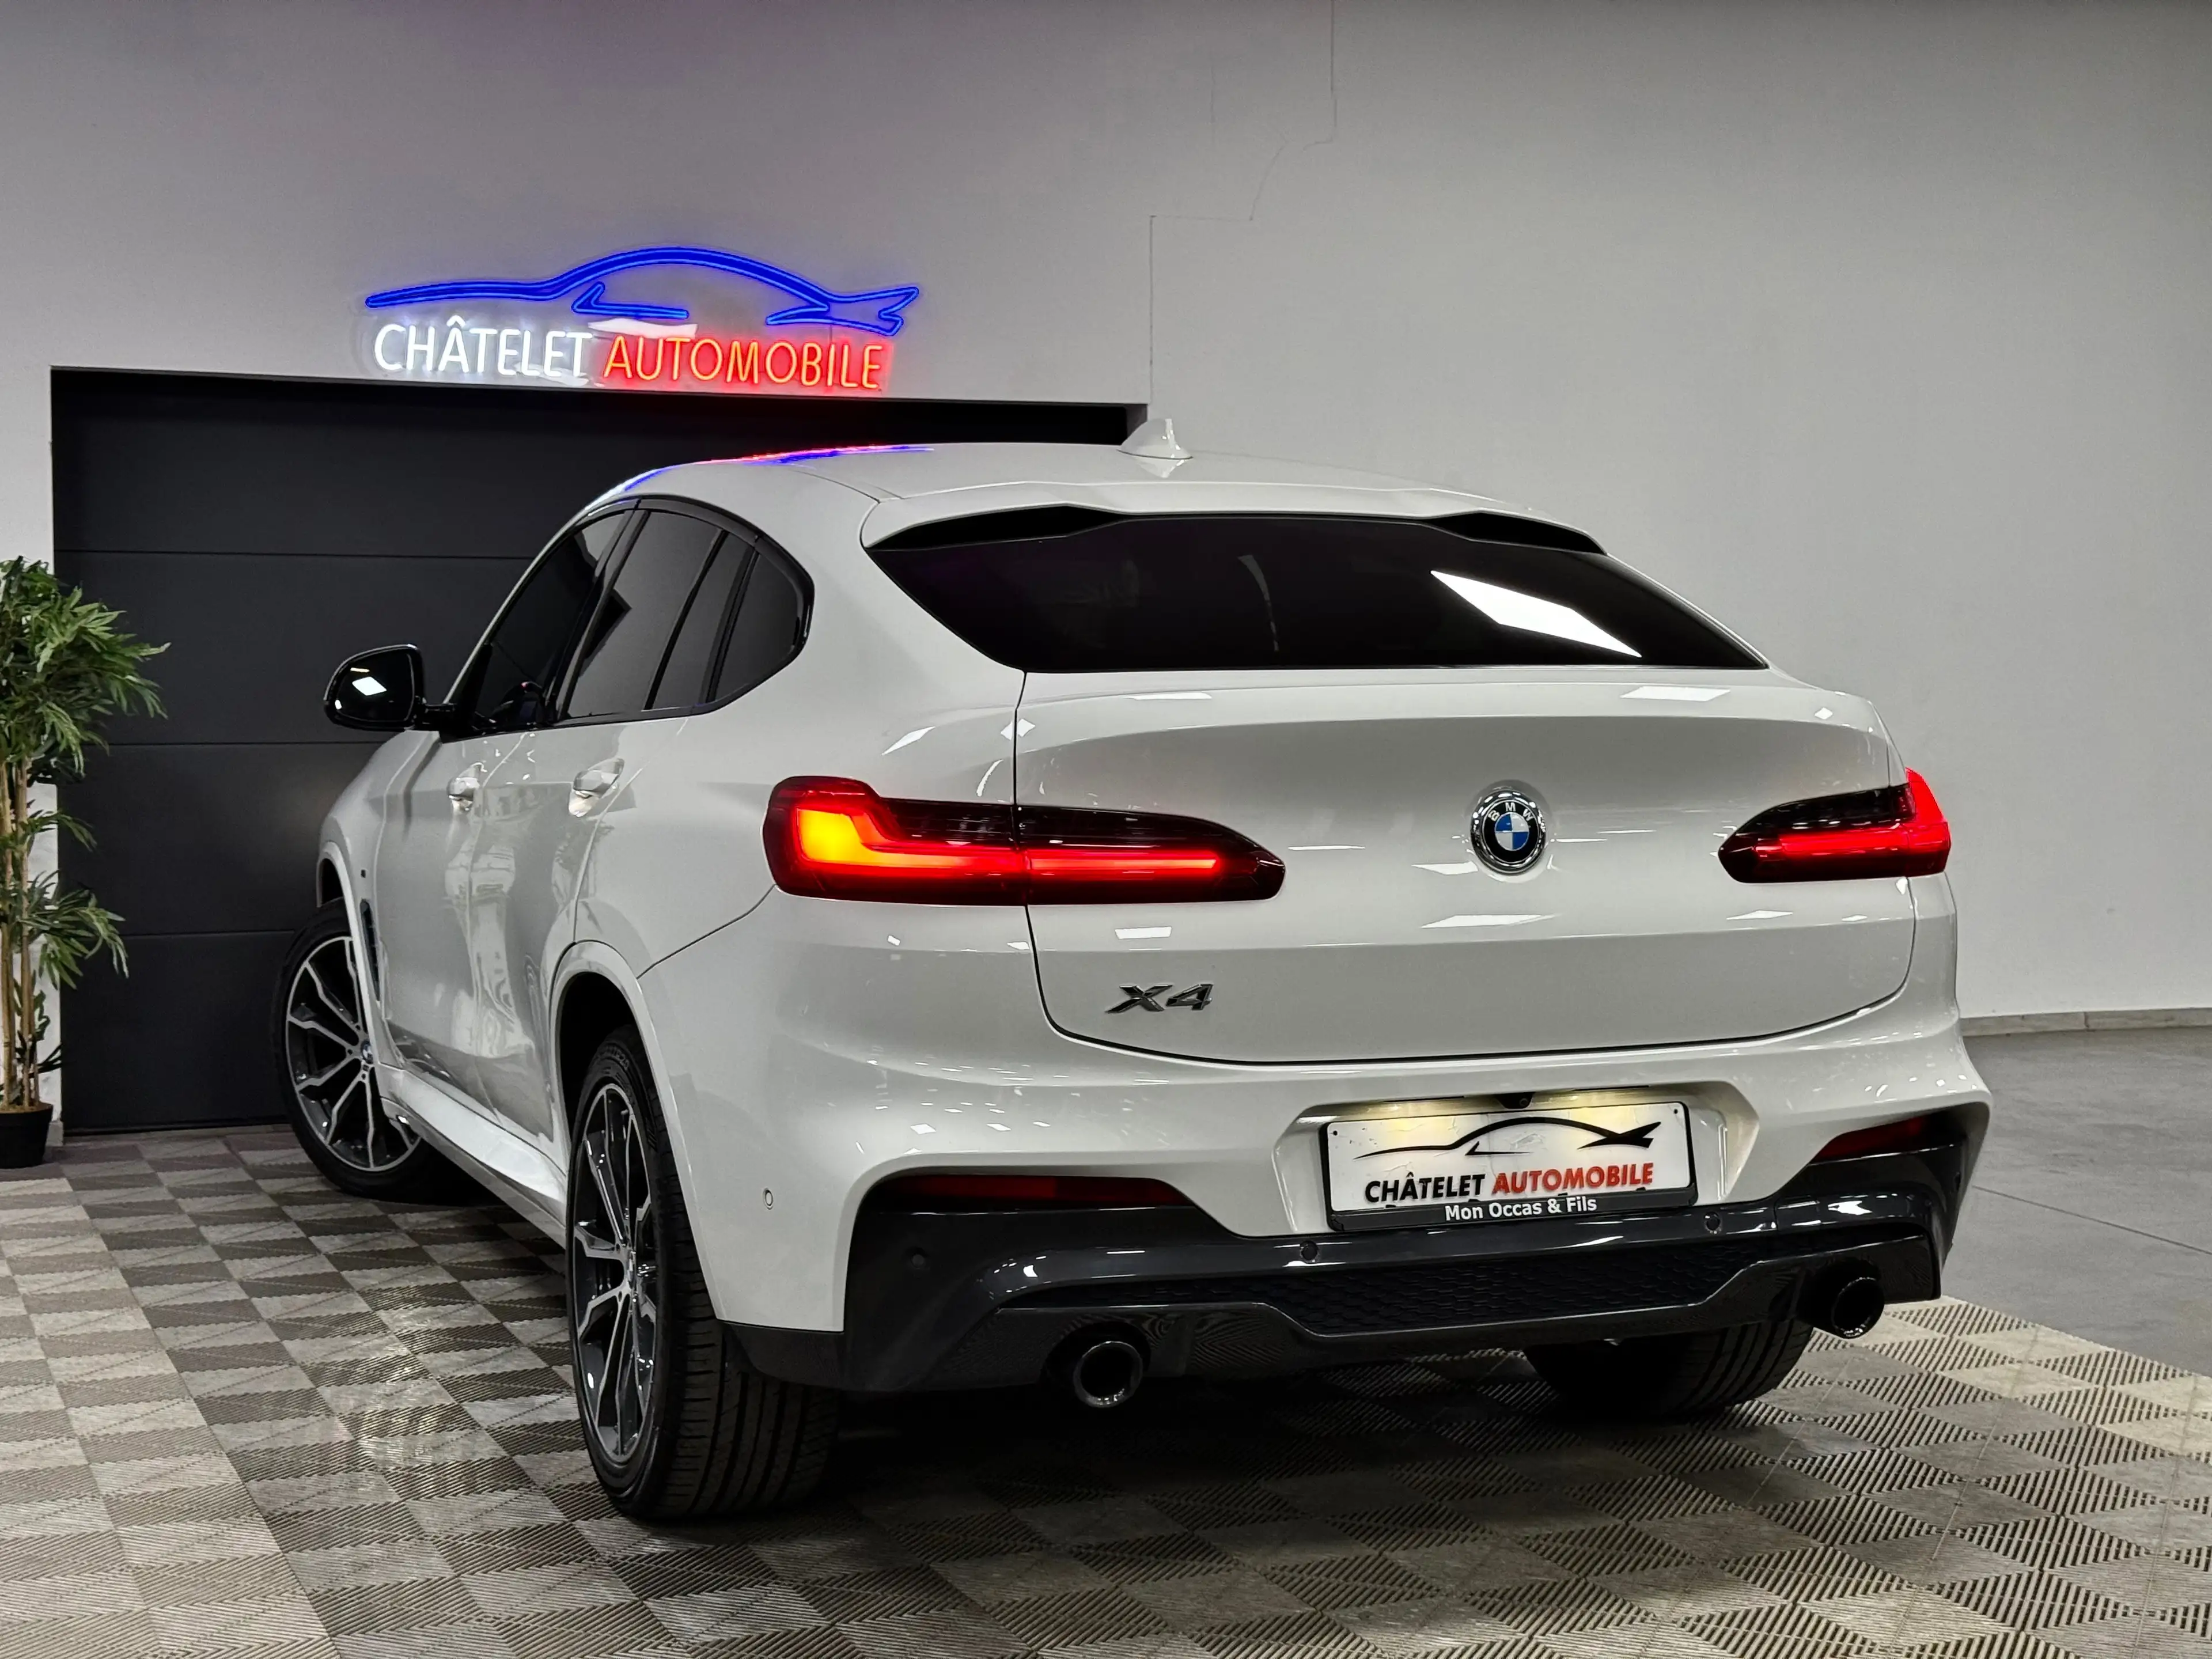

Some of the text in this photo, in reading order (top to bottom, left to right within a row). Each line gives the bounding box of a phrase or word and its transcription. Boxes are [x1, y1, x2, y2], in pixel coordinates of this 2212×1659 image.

[374, 315, 883, 389] CHÂTELET AUTOMOBILE
[1488, 802, 1533, 821] BMW
[1105, 984, 1213, 1013] X4
[1365, 1162, 1653, 1203] CHÂTELET AUTOMOBILE
[1445, 1196, 1597, 1221] Mon Occas & Fils
